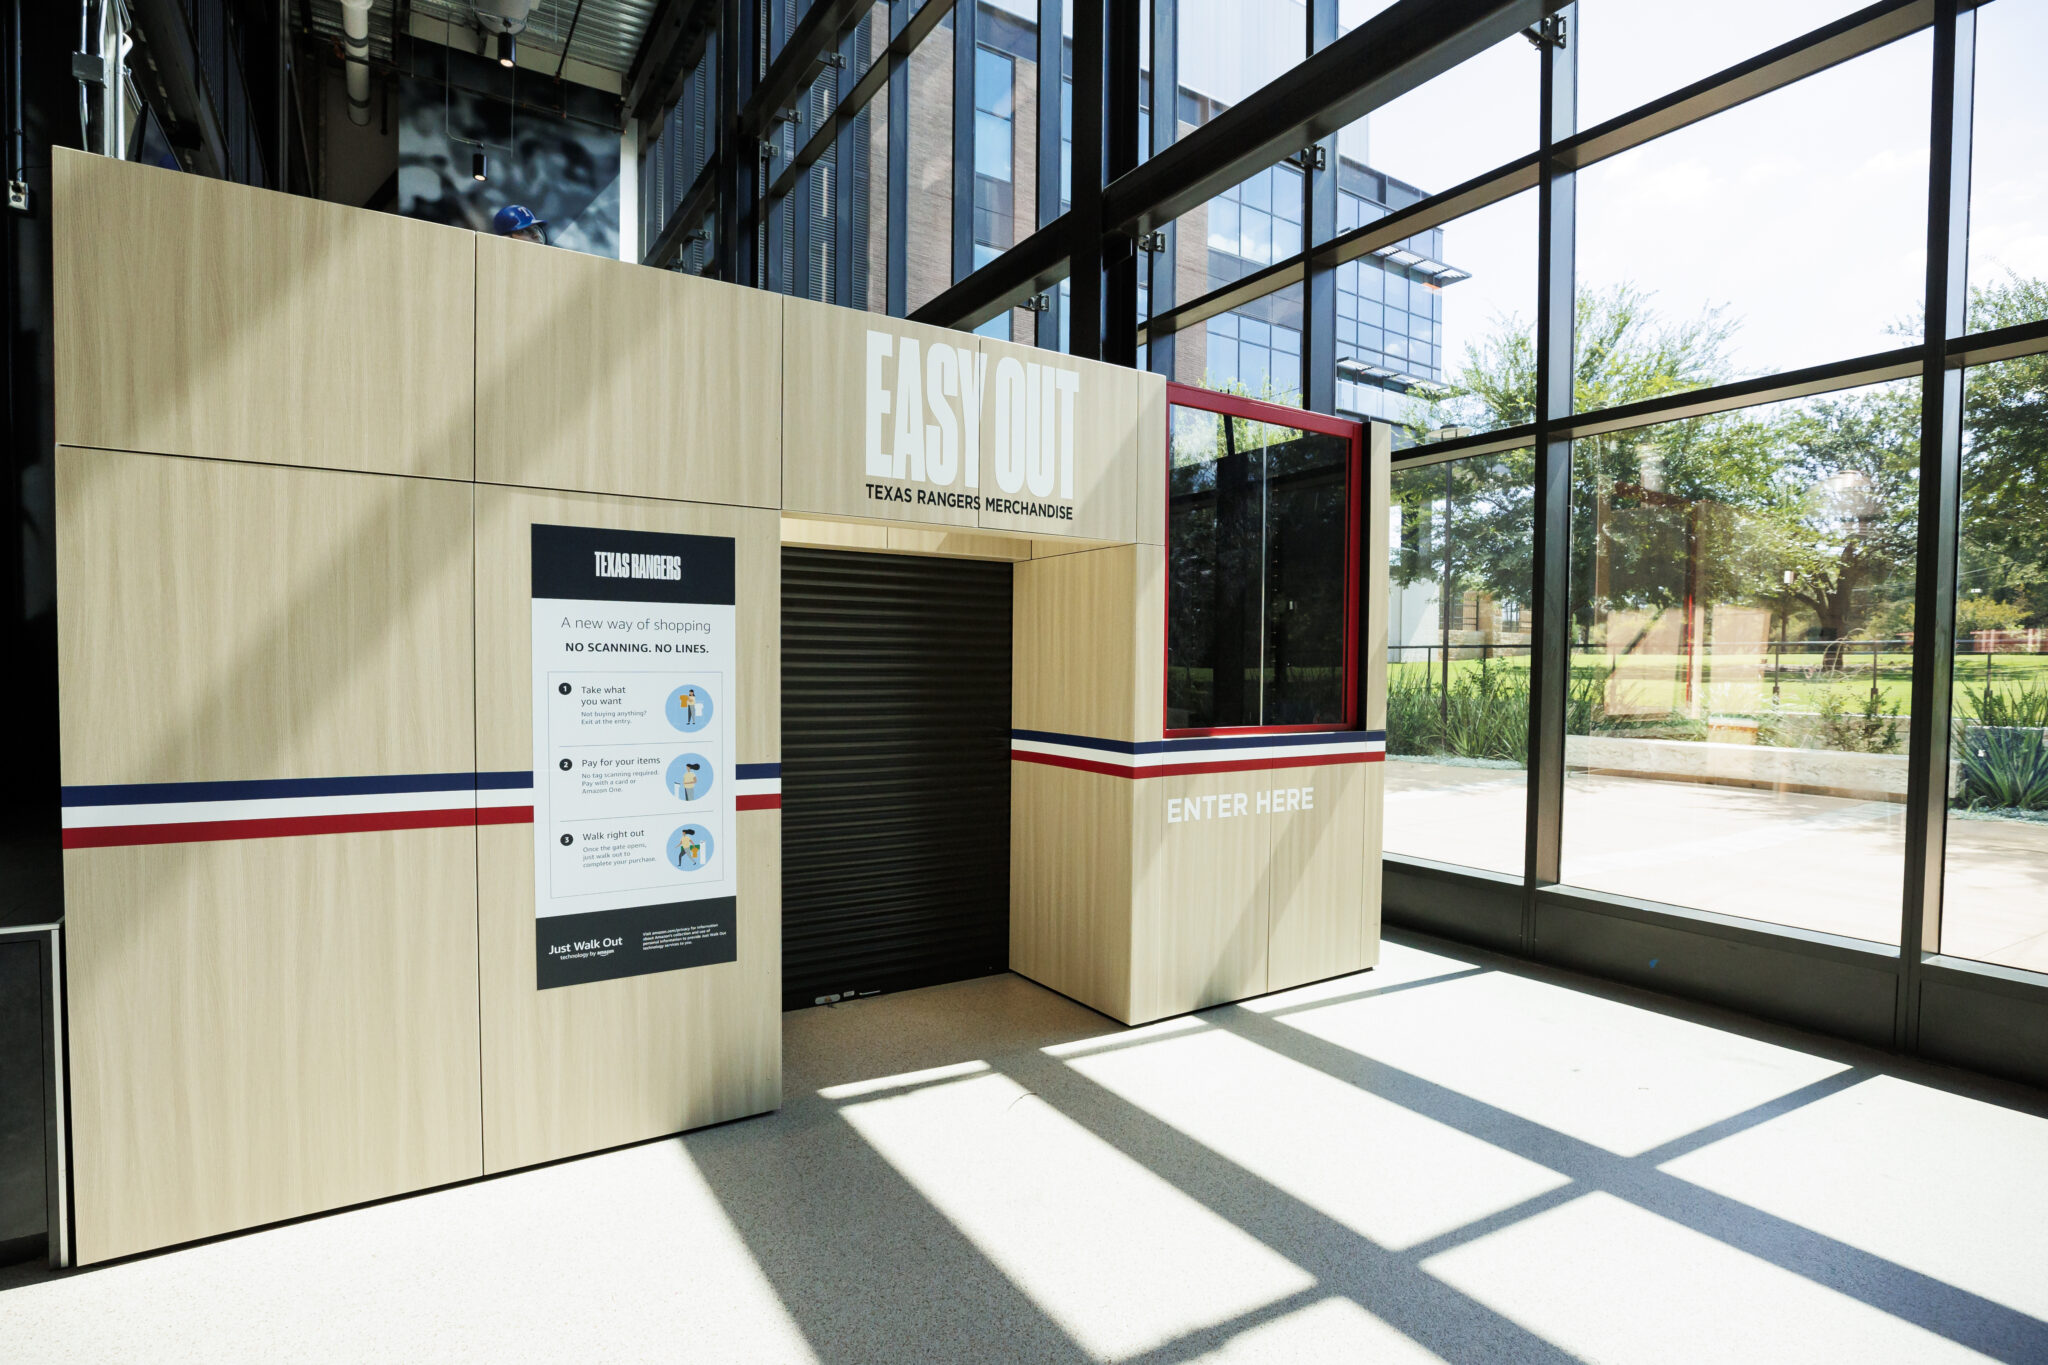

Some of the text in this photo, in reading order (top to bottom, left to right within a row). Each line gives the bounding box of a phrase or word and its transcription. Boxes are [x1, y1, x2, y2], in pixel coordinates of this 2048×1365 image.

[866, 330, 1080, 499] EASY OUT
[866, 484, 1073, 520] TEXAS RANGERS MERCHANDISE
[594, 551, 681, 580] TEXAS RANGERS
[561, 616, 711, 634] A new way of shopping
[566, 642, 709, 654] NO SCANNING. NO LINES.
[604, 686, 626, 694] what
[581, 699, 598, 707] you
[582, 759, 598, 768] Pay
[600, 758, 612, 766] for
[616, 759, 634, 767] your
[1168, 787, 1314, 824] ENTER HERE
[583, 832, 604, 840] Walk
[607, 830, 627, 840] right
[549, 937, 623, 955] Just Walk Out
